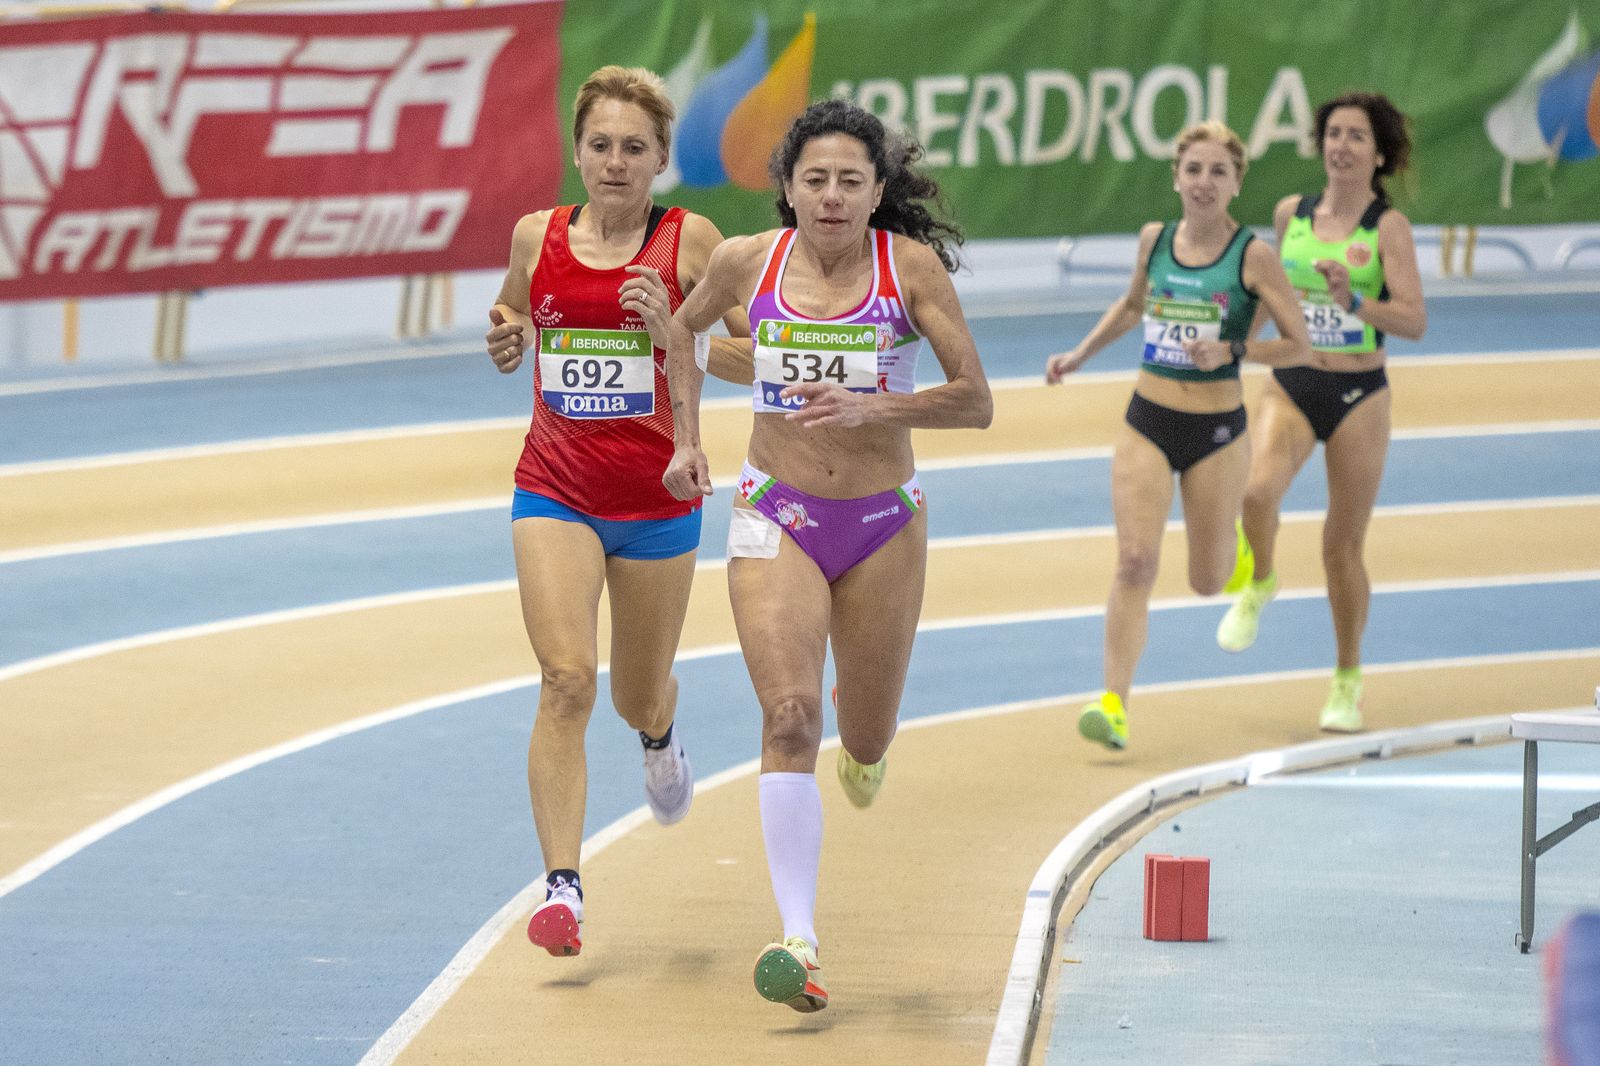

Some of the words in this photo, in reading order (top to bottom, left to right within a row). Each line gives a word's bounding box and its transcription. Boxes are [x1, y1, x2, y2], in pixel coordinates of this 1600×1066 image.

[73, 28, 516, 198] RFEA
[831, 64, 1316, 168] BERDROLA
[32, 189, 471, 274] ATLETISMO
[1305, 306, 1342, 329] 85
[572, 338, 640, 350] IBERDROLA
[792, 331, 865, 345] IBERDROLA
[561, 359, 624, 389] 692
[782, 353, 848, 384] 534
